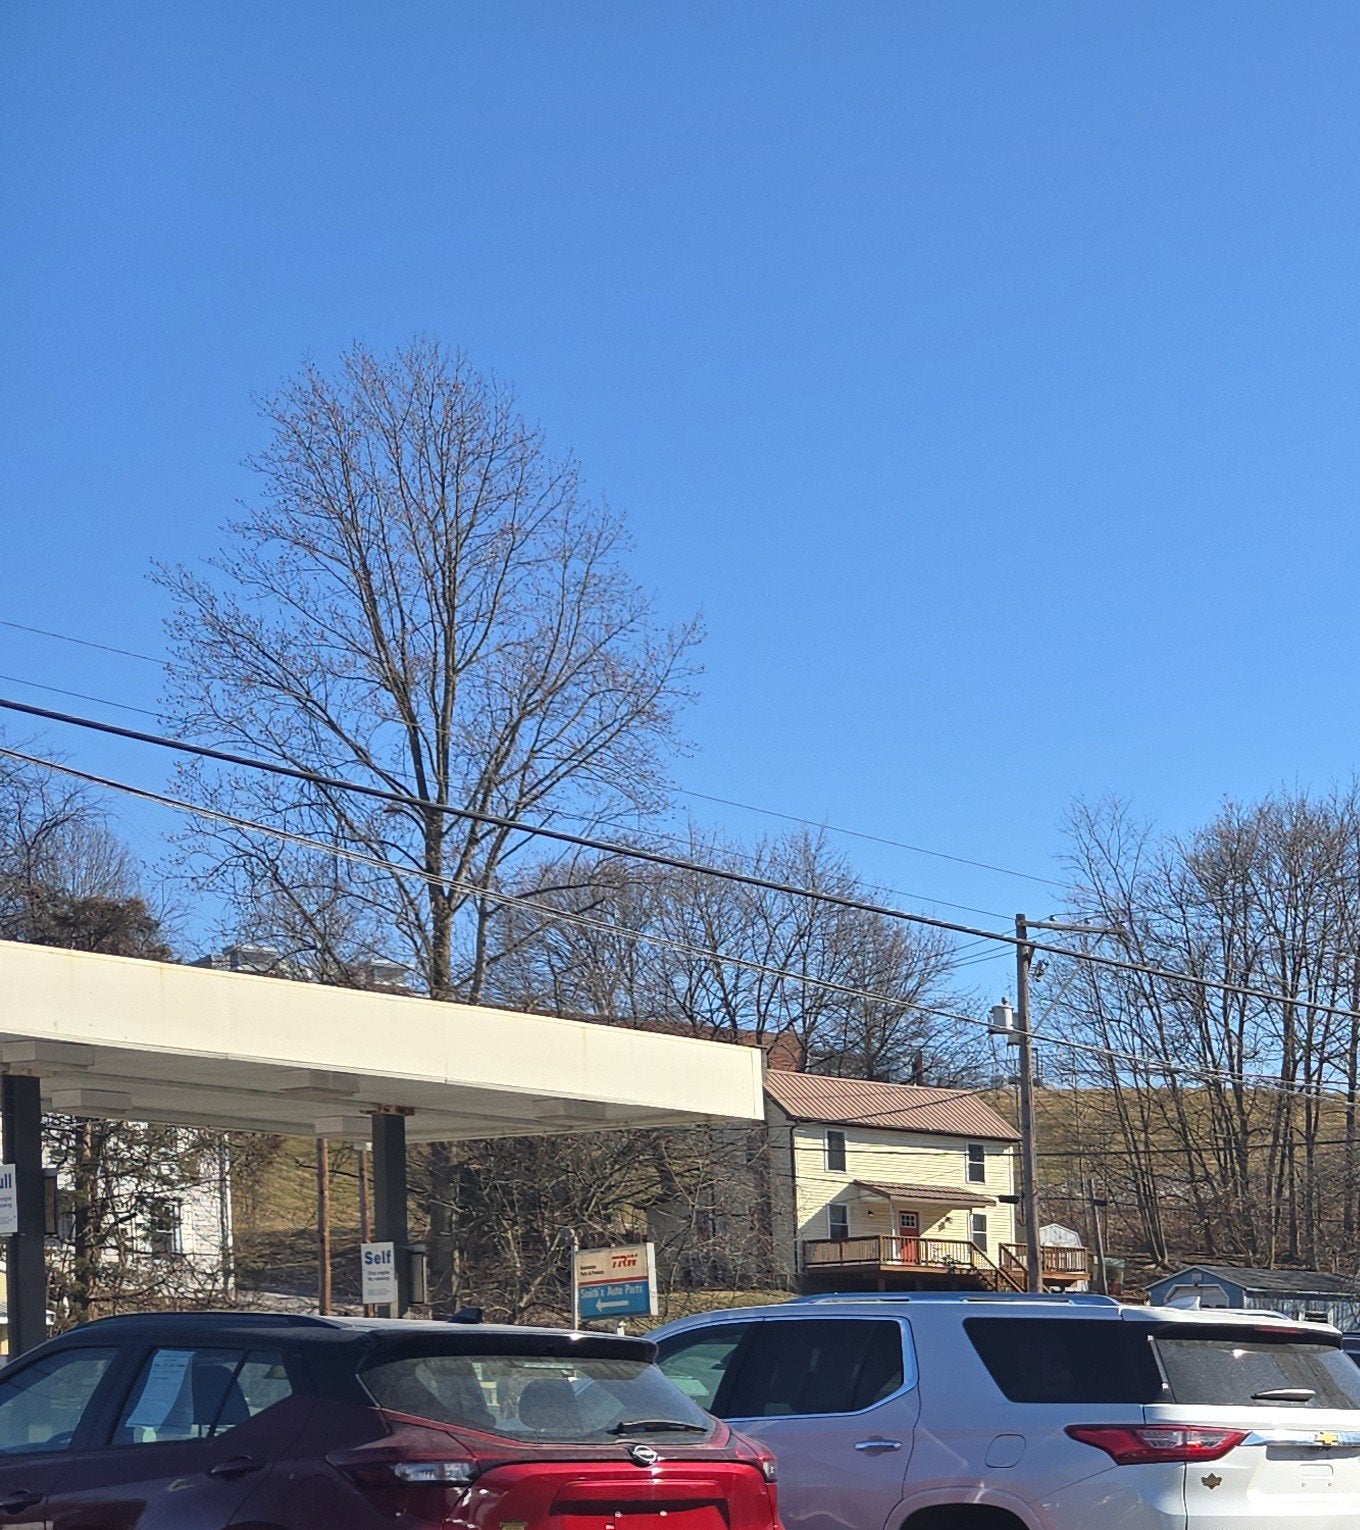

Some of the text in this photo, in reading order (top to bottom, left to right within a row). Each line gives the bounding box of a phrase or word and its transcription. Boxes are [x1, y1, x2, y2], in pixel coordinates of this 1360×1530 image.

[364, 1250, 391, 1265] Self
[607, 1286, 623, 1296] Auto
[624, 1284, 643, 1294] Parts
